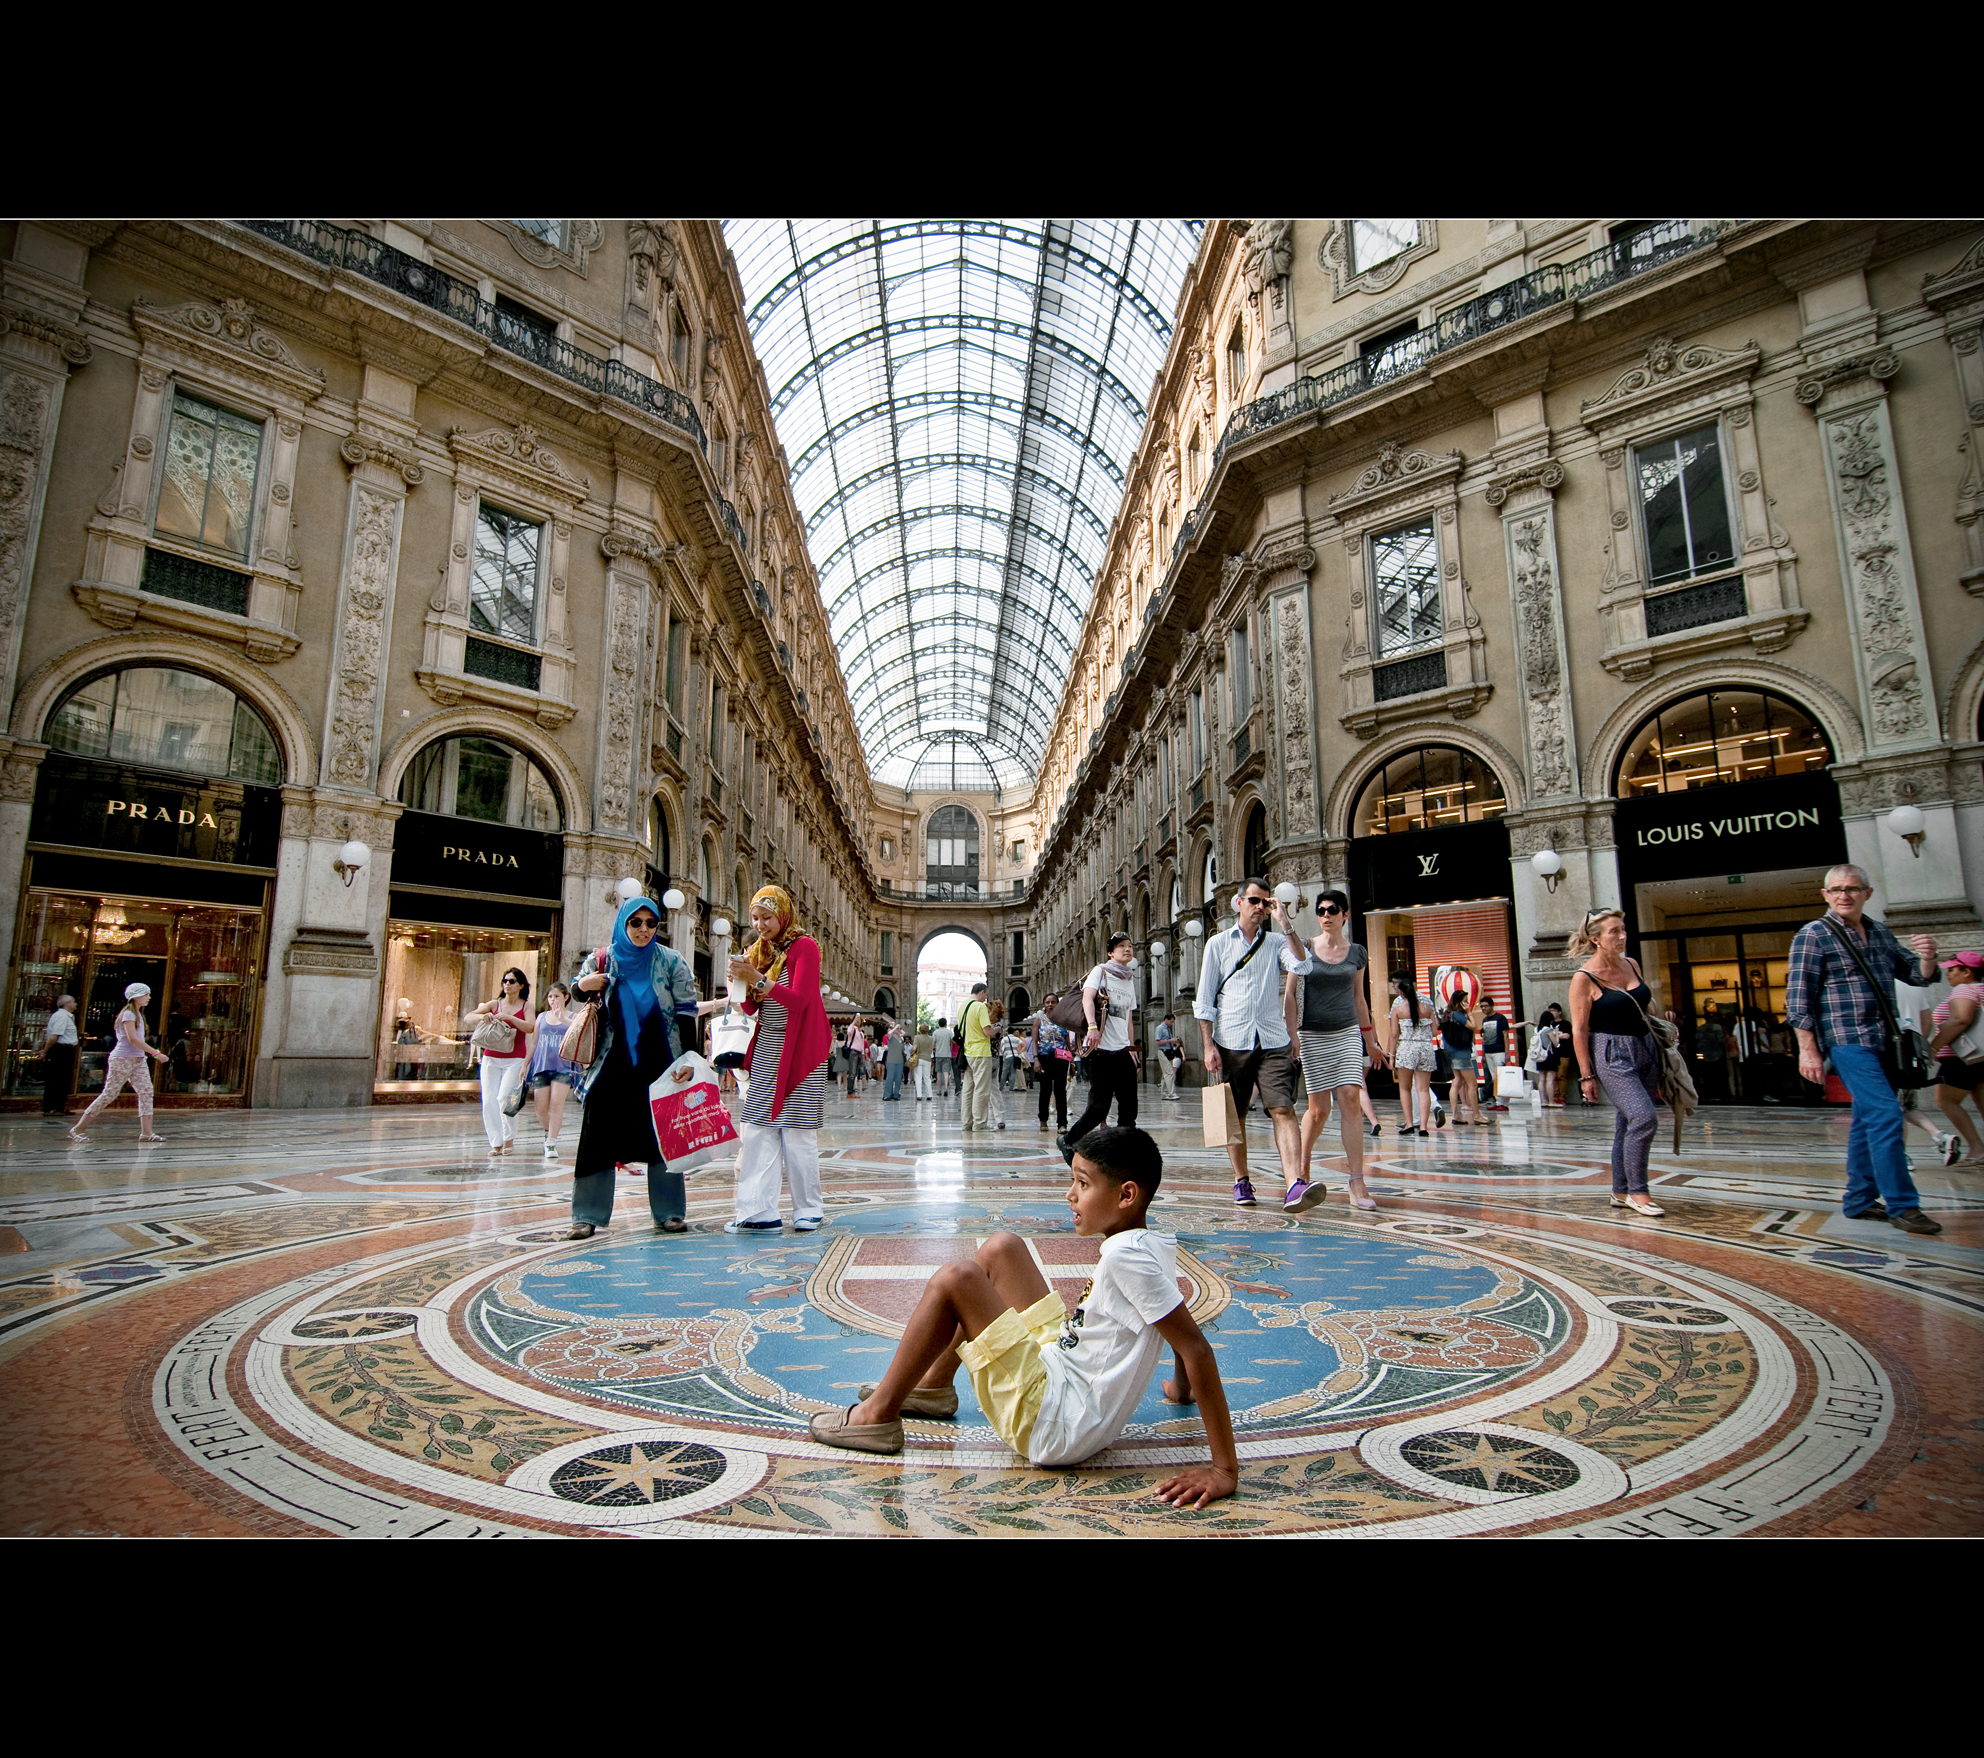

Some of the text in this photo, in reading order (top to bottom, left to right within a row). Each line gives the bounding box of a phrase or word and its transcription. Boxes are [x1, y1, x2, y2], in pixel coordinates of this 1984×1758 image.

[106, 799, 217, 829] PRADA
[1637, 807, 1819, 846] LOUIS VUITTON
[443, 846, 519, 868] PRADA
[1416, 852, 1440, 877] LV
[1814, 1386, 1883, 1438] FERT
[171, 1408, 265, 1461] FERT
